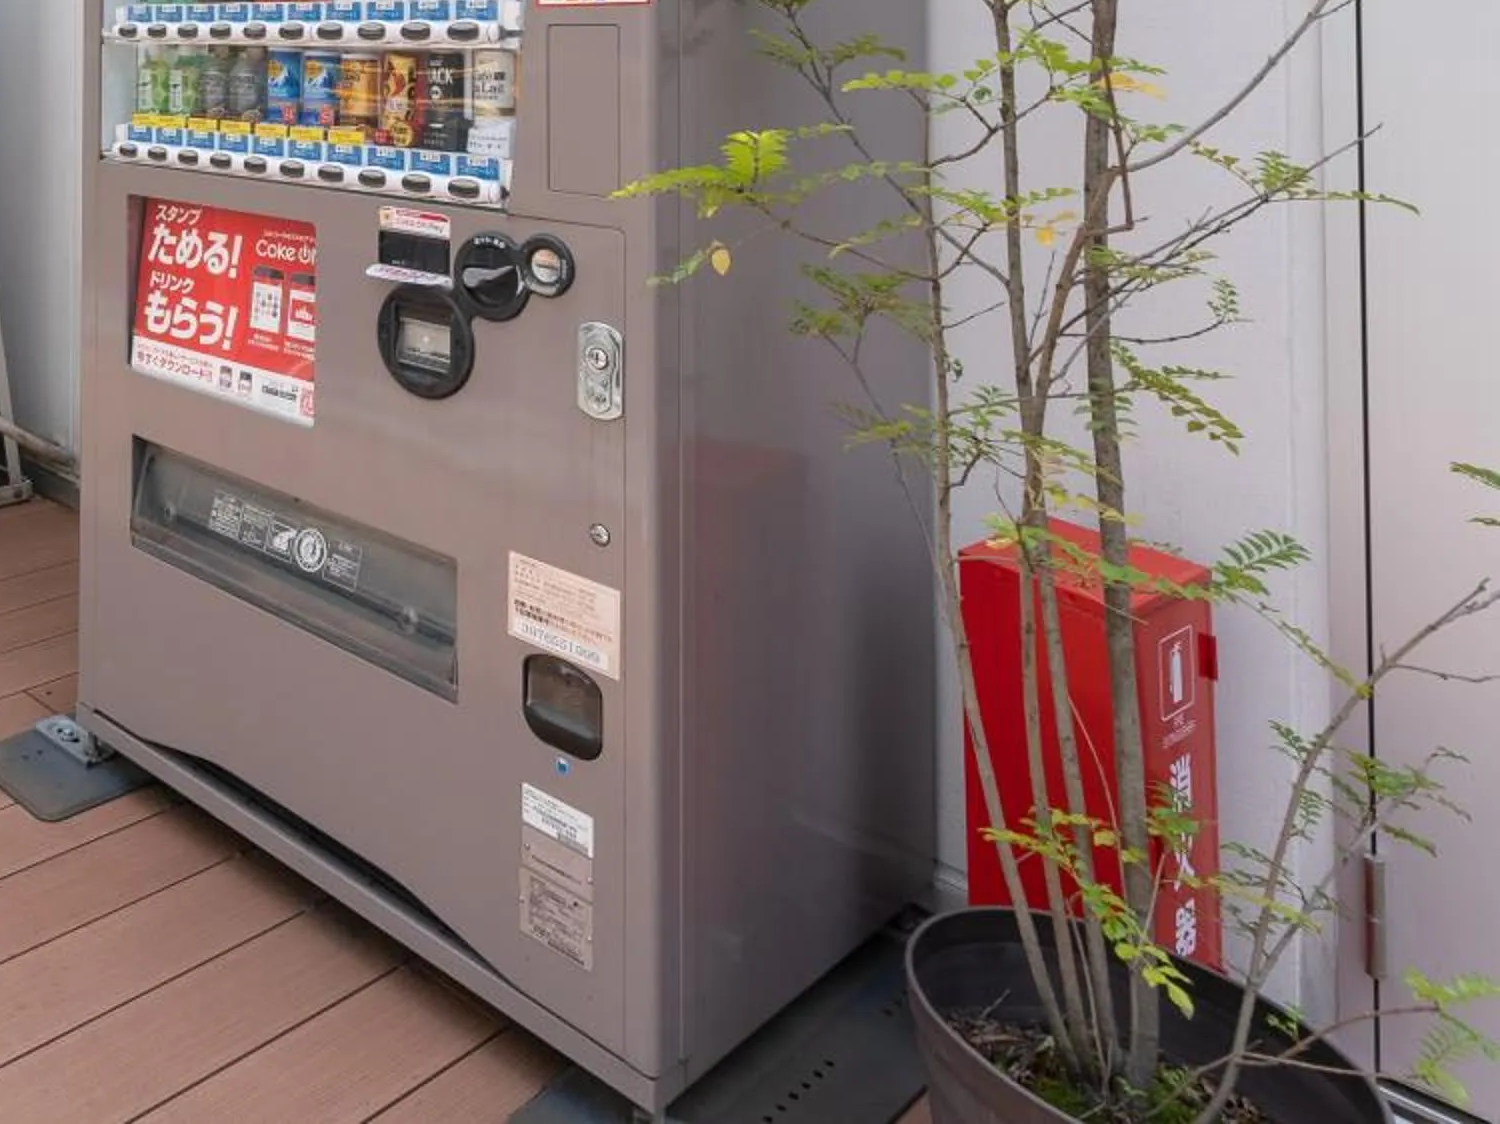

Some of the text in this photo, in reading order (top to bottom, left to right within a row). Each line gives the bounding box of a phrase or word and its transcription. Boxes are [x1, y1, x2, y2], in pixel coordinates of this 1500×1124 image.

[155, 204, 203, 225] スタンプ
[148, 223, 243, 280] ためる!
[255, 239, 296, 261] Coke
[150, 270, 195, 295] ドリンク
[144, 288, 239, 351] もらう!
